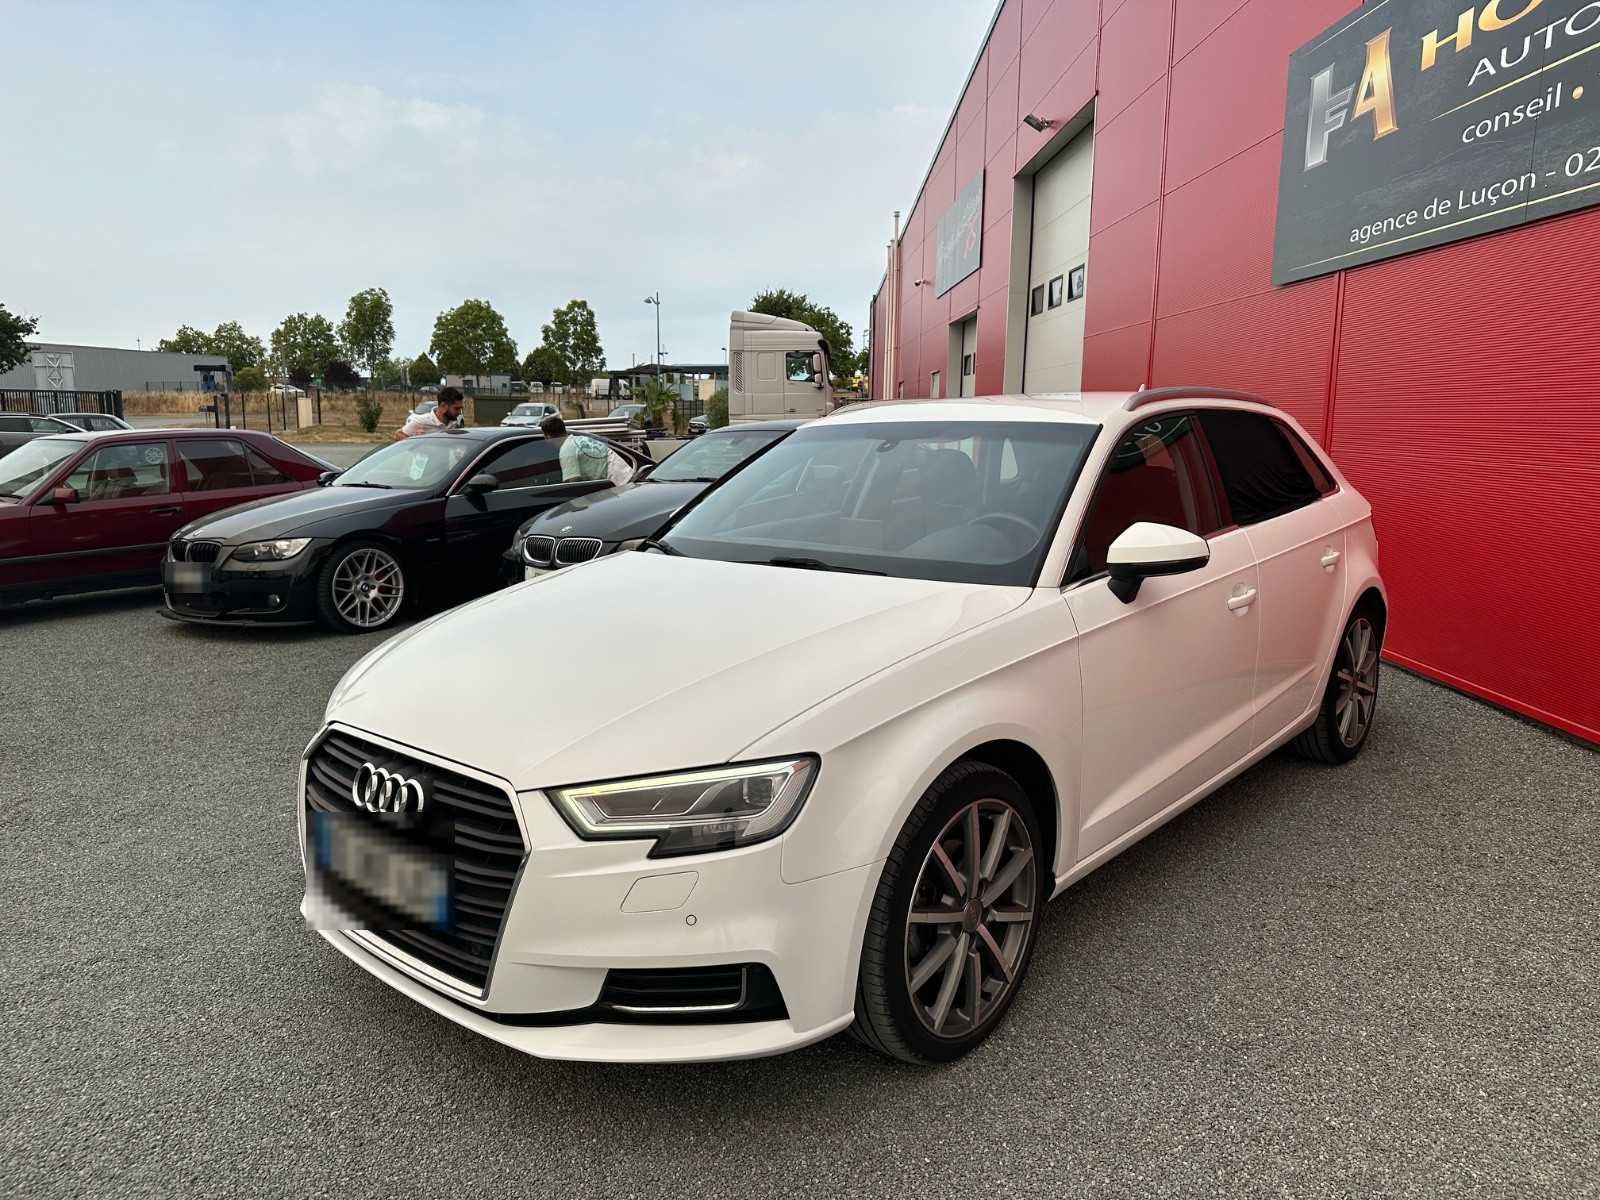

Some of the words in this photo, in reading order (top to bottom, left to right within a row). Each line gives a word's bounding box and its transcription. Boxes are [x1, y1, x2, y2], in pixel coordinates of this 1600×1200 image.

[1467, 1, 1600, 87] AUTO
[1462, 82, 1562, 143] conseil
[1350, 210, 1418, 244] agence
[1423, 197, 1451, 220] de
[1458, 171, 1536, 206] Luçon
[1564, 146, 1600, 177] 02
